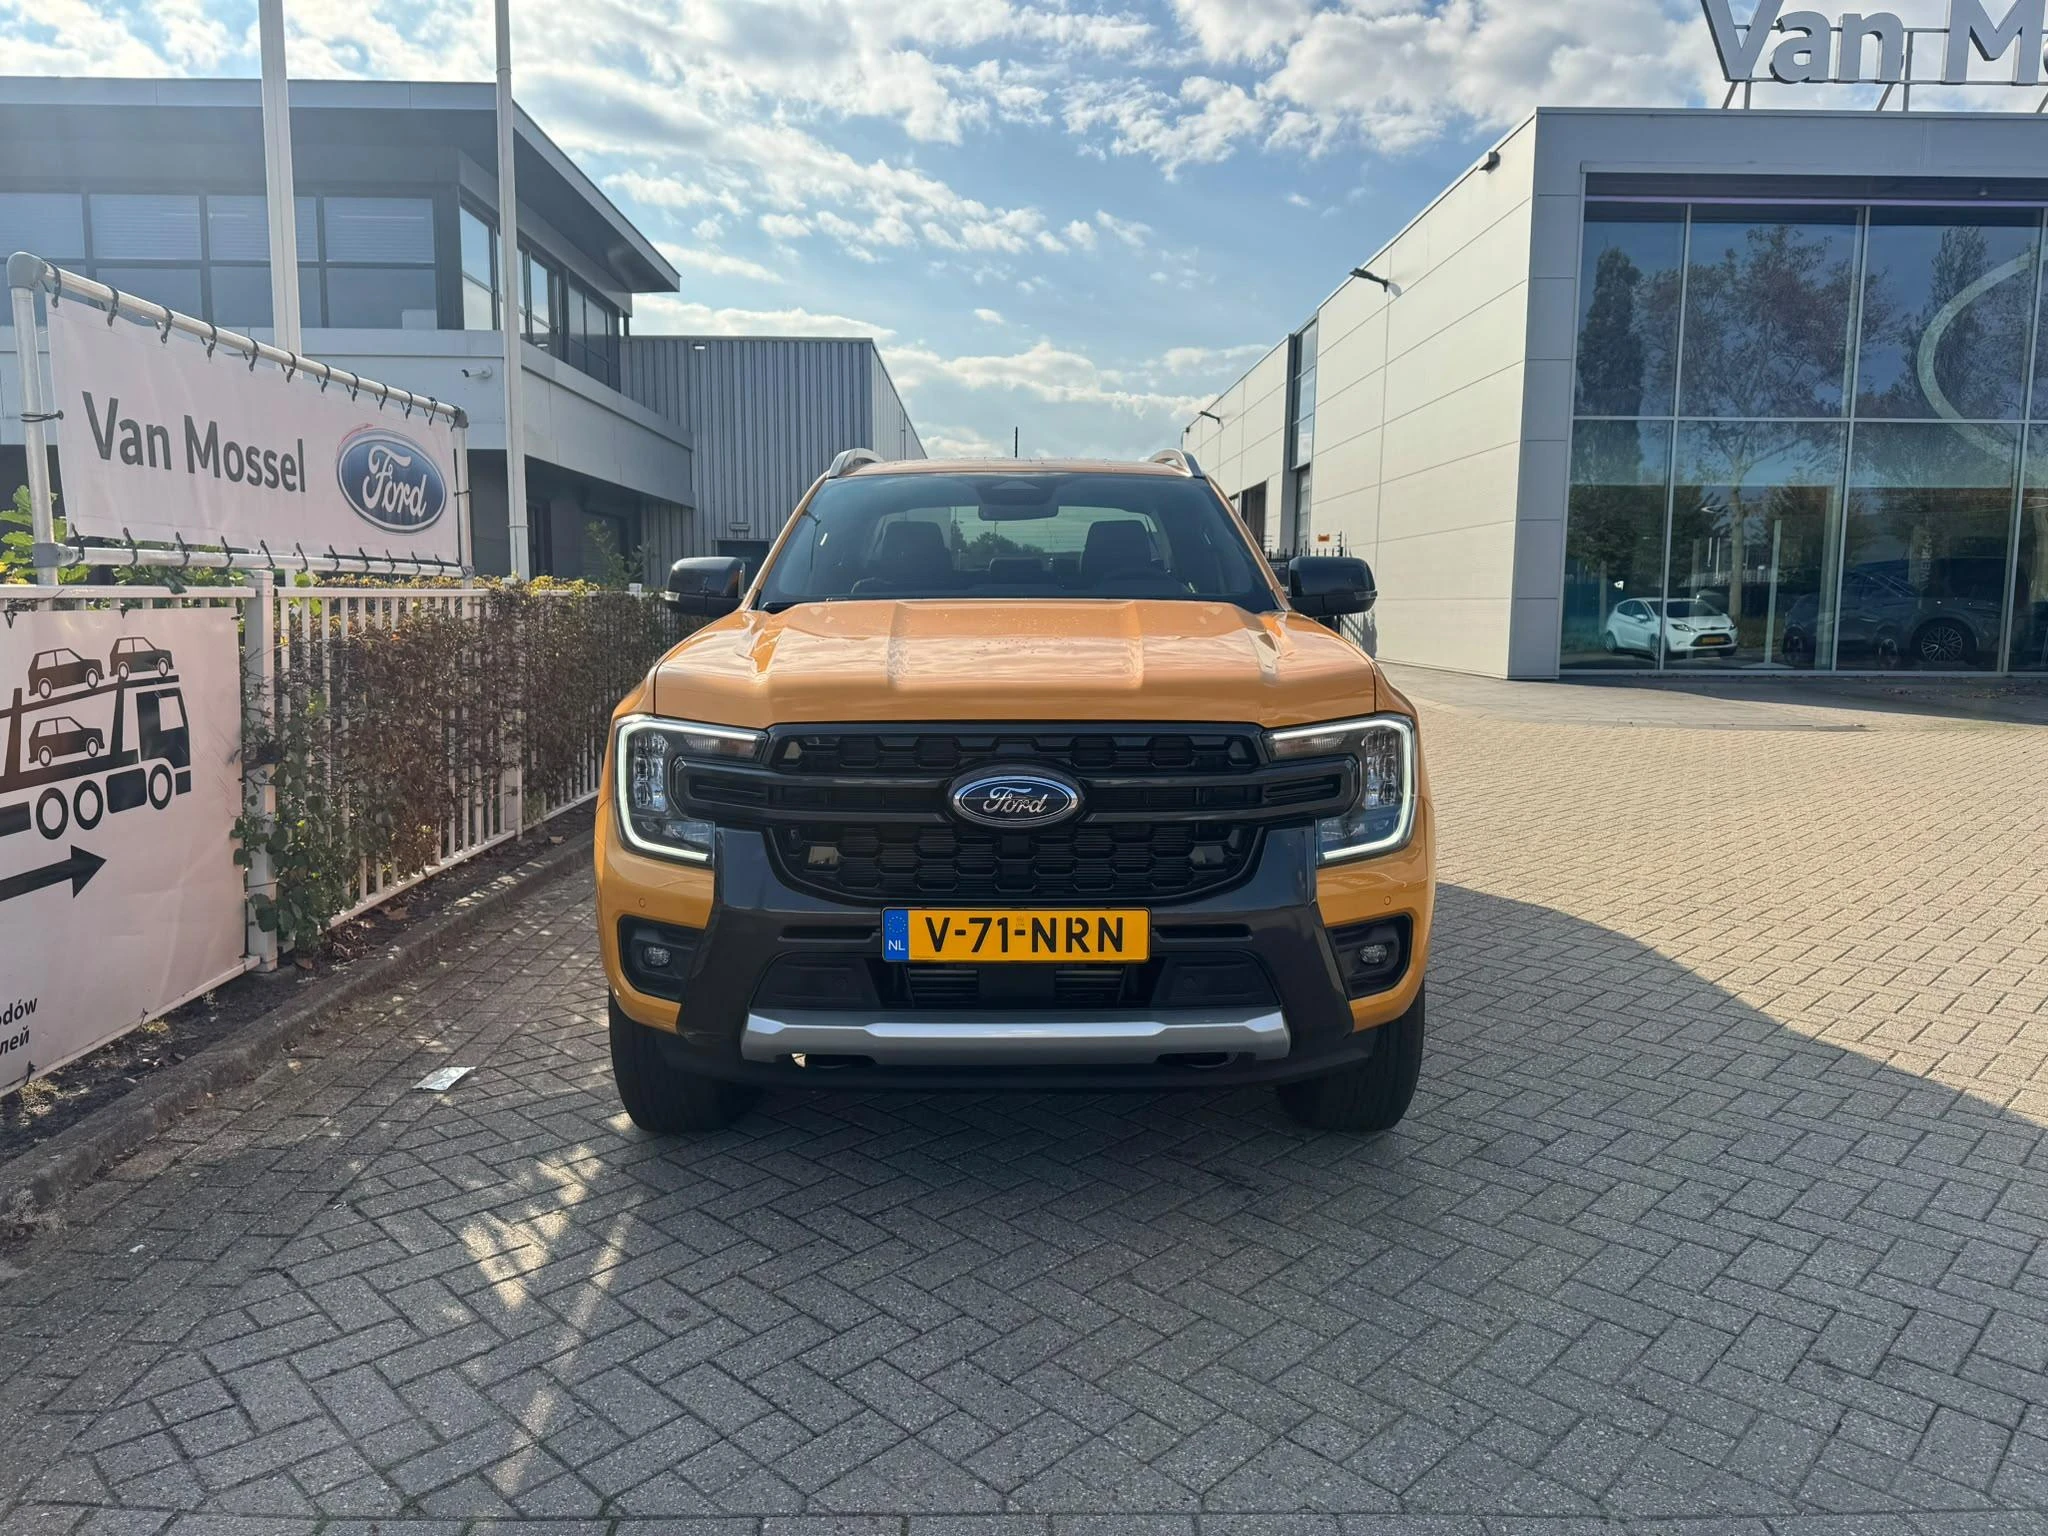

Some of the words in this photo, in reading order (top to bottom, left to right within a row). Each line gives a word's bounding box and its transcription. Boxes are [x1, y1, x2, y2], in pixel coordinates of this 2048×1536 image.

[1700, 0, 1905, 84] Van
[1943, 0, 2048, 87] M
[82, 390, 173, 471] Van
[183, 414, 307, 493] Mossel
[361, 443, 429, 518] Ford
[982, 785, 1049, 814] Ford
[888, 939, 906, 951] NL
[924, 916, 1124, 953] V-71-NRN
[0, 997, 38, 1026] dów
